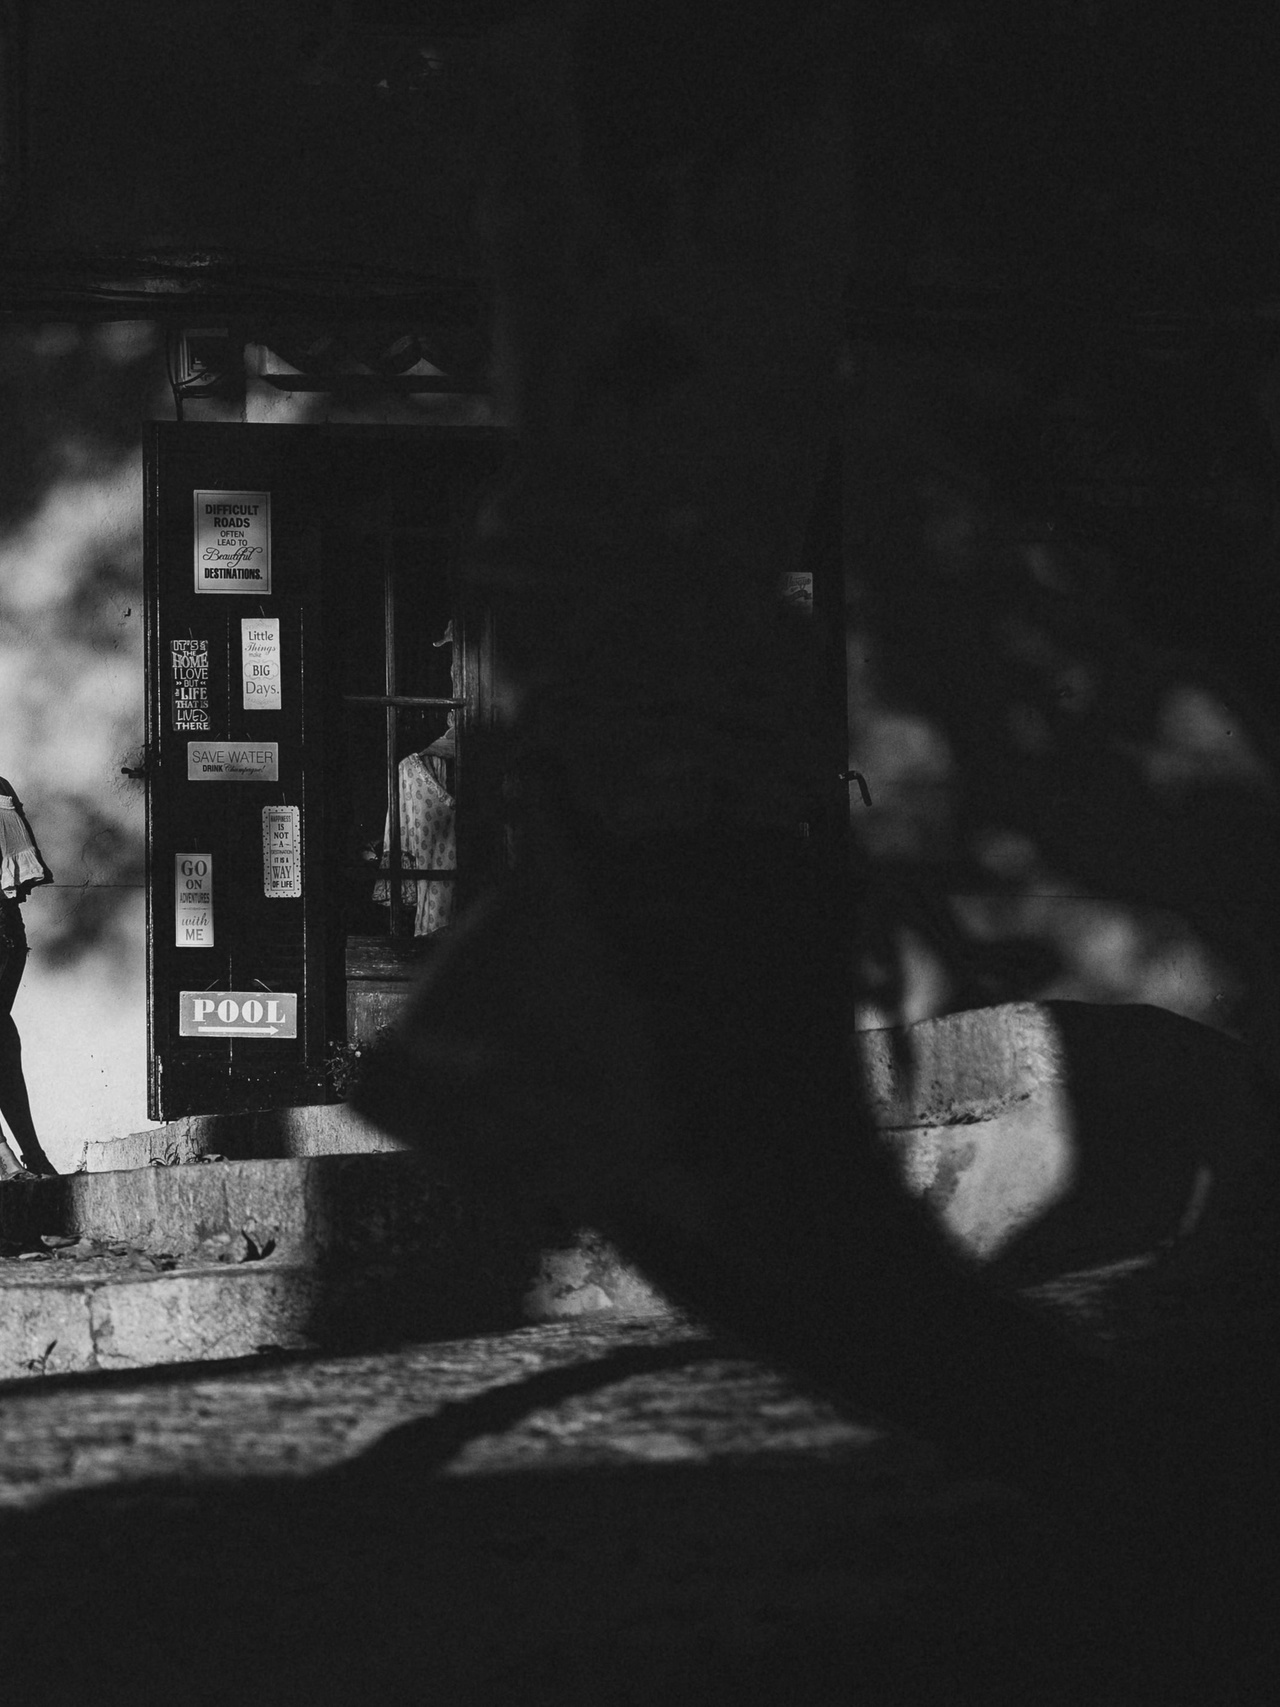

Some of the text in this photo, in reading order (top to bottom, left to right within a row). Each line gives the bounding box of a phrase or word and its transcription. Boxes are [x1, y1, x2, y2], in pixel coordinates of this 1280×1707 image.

[205, 504, 259, 516] DIFFICULT
[214, 517, 250, 528] ROADS
[220, 530, 244, 538] OFTEN
[202, 547, 263, 568] Beautiful
[204, 568, 263, 580] DESTINATIONS.
[248, 631, 274, 641] Little
[173, 640, 199, 651] IT'S
[244, 642, 276, 655] Things
[171, 651, 209, 669] HOME
[174, 668, 209, 680] I LOVE
[252, 664, 270, 677] BIG
[183, 679, 199, 688] BUT
[245, 681, 280, 697] Days.
[180, 687, 208, 700] LIFE
[175, 700, 209, 709] THAT IS
[177, 708, 208, 722] LIVED
[175, 722, 209, 730] THERE
[192, 750, 274, 763] SAVE WATER
[202, 764, 223, 773] DRINK
[277, 823, 285, 831] IS
[273, 831, 290, 840] NOT
[278, 840, 285, 848] A
[181, 860, 208, 877] GO
[272, 865, 292, 879] WAY
[185, 879, 203, 890] ON
[272, 880, 293, 888] OF LIFE
[181, 912, 210, 926] with
[185, 928, 204, 941] ME
[192, 999, 286, 1024] POOL
